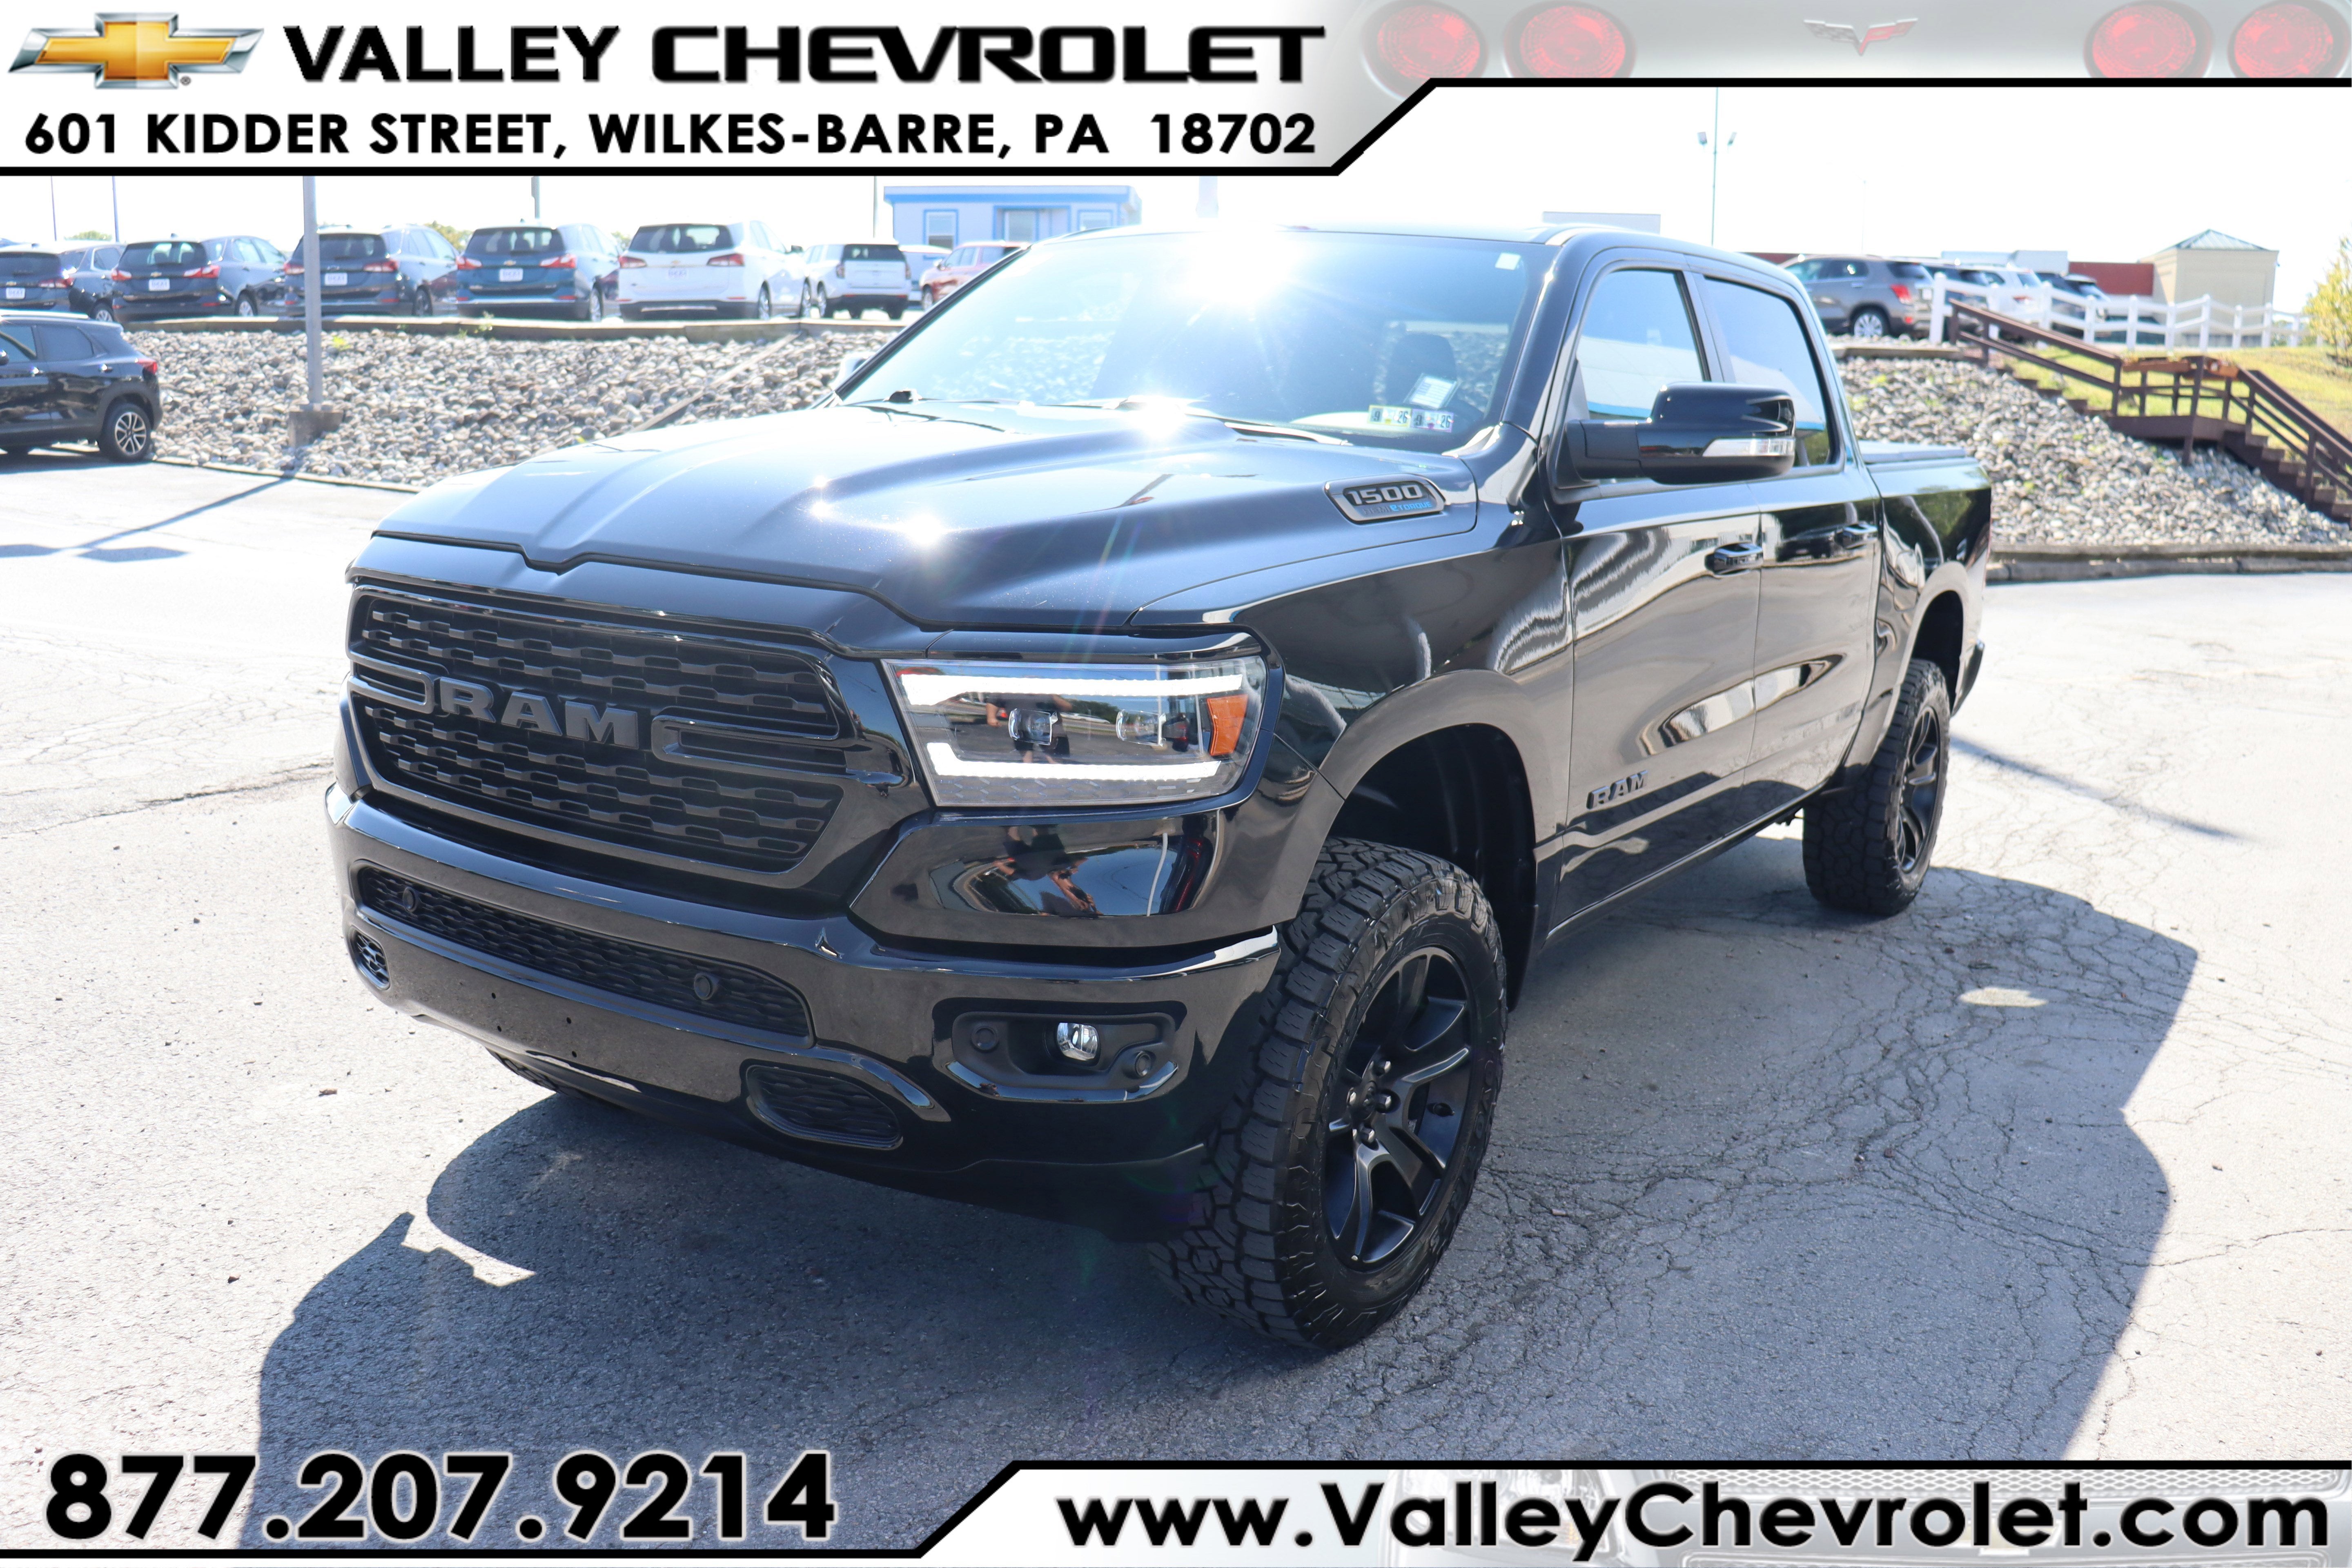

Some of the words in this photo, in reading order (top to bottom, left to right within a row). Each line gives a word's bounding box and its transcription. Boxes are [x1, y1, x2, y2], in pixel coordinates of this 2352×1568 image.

[1397, 410, 1409, 423] 26
[1440, 414, 1452, 428] 26
[1348, 484, 1423, 505] 1500
[440, 676, 639, 750] RAM
[1586, 770, 1648, 809] RAM
